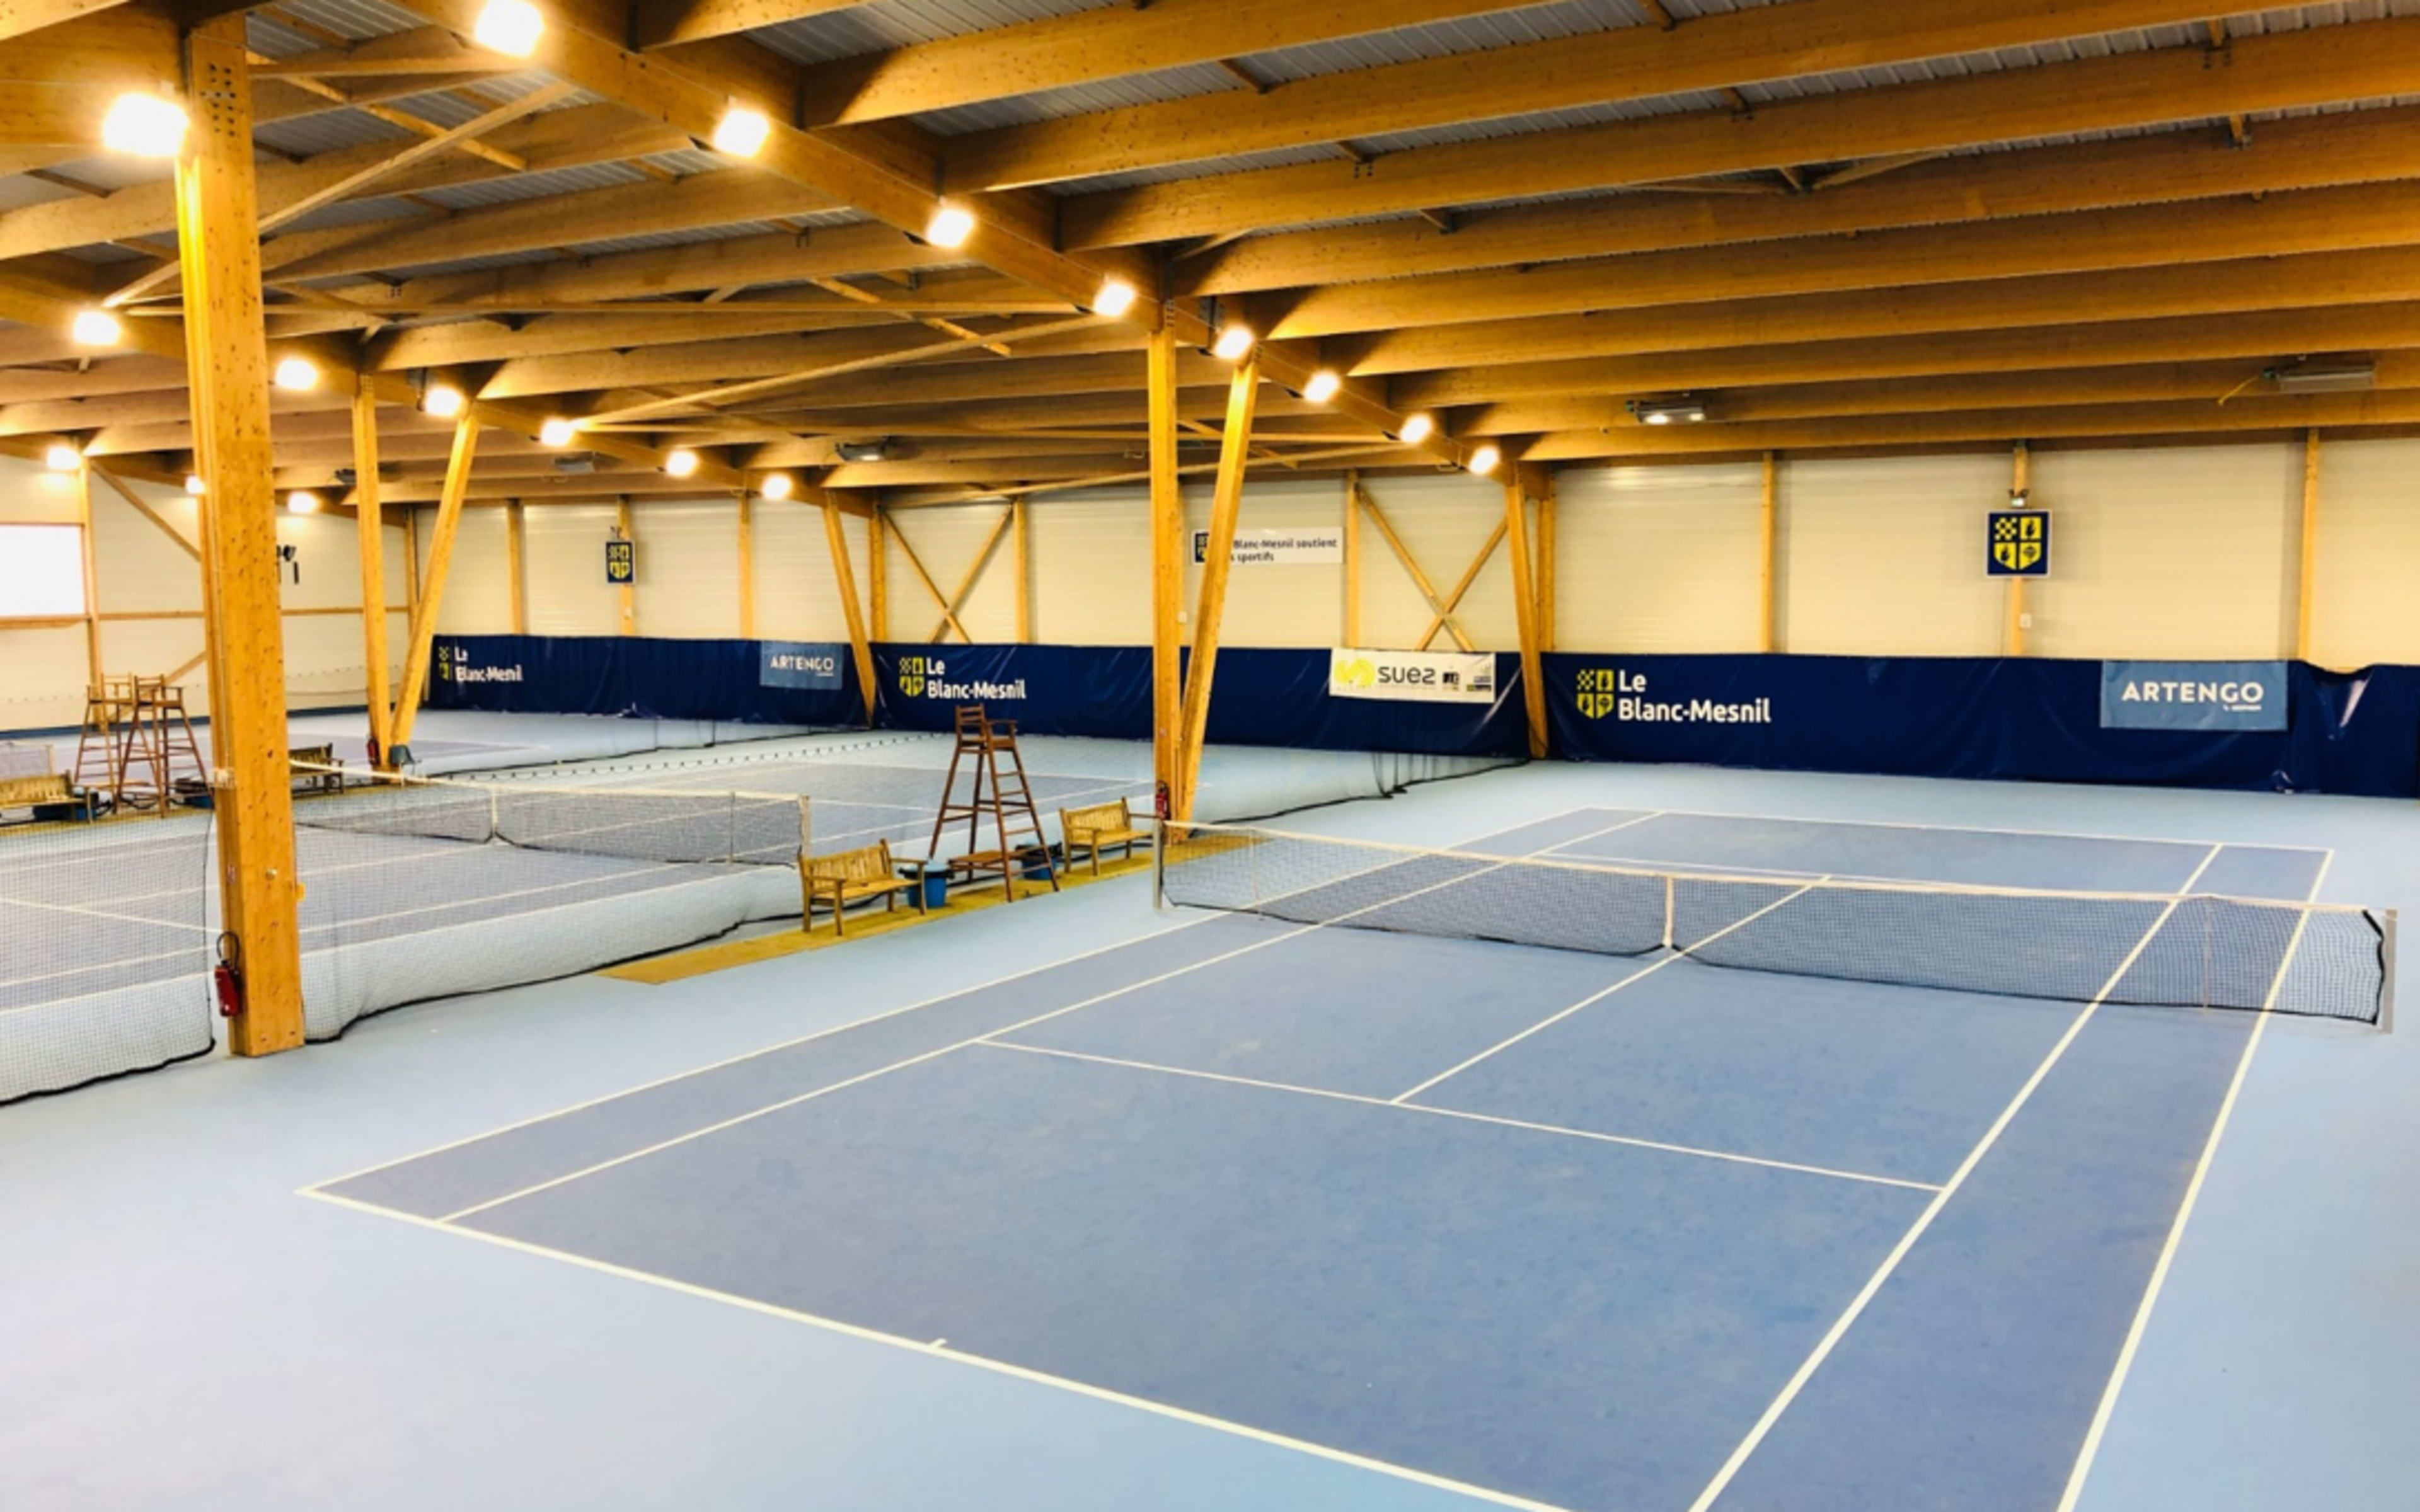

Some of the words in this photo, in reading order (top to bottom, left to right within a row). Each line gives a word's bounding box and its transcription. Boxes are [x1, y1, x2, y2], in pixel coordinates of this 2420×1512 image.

[1296, 537, 1337, 547] soutient
[1237, 551, 1274, 563] sportifs
[454, 646, 468, 662] Le
[770, 655, 834, 670] ARTENGO
[926, 657, 945, 675] Le
[927, 679, 1027, 699] Blanc-Mesnil
[1618, 669, 1647, 692] Le
[2121, 681, 2264, 703] ARTENGO
[1618, 696, 1772, 723] Blanc-Mesnil
